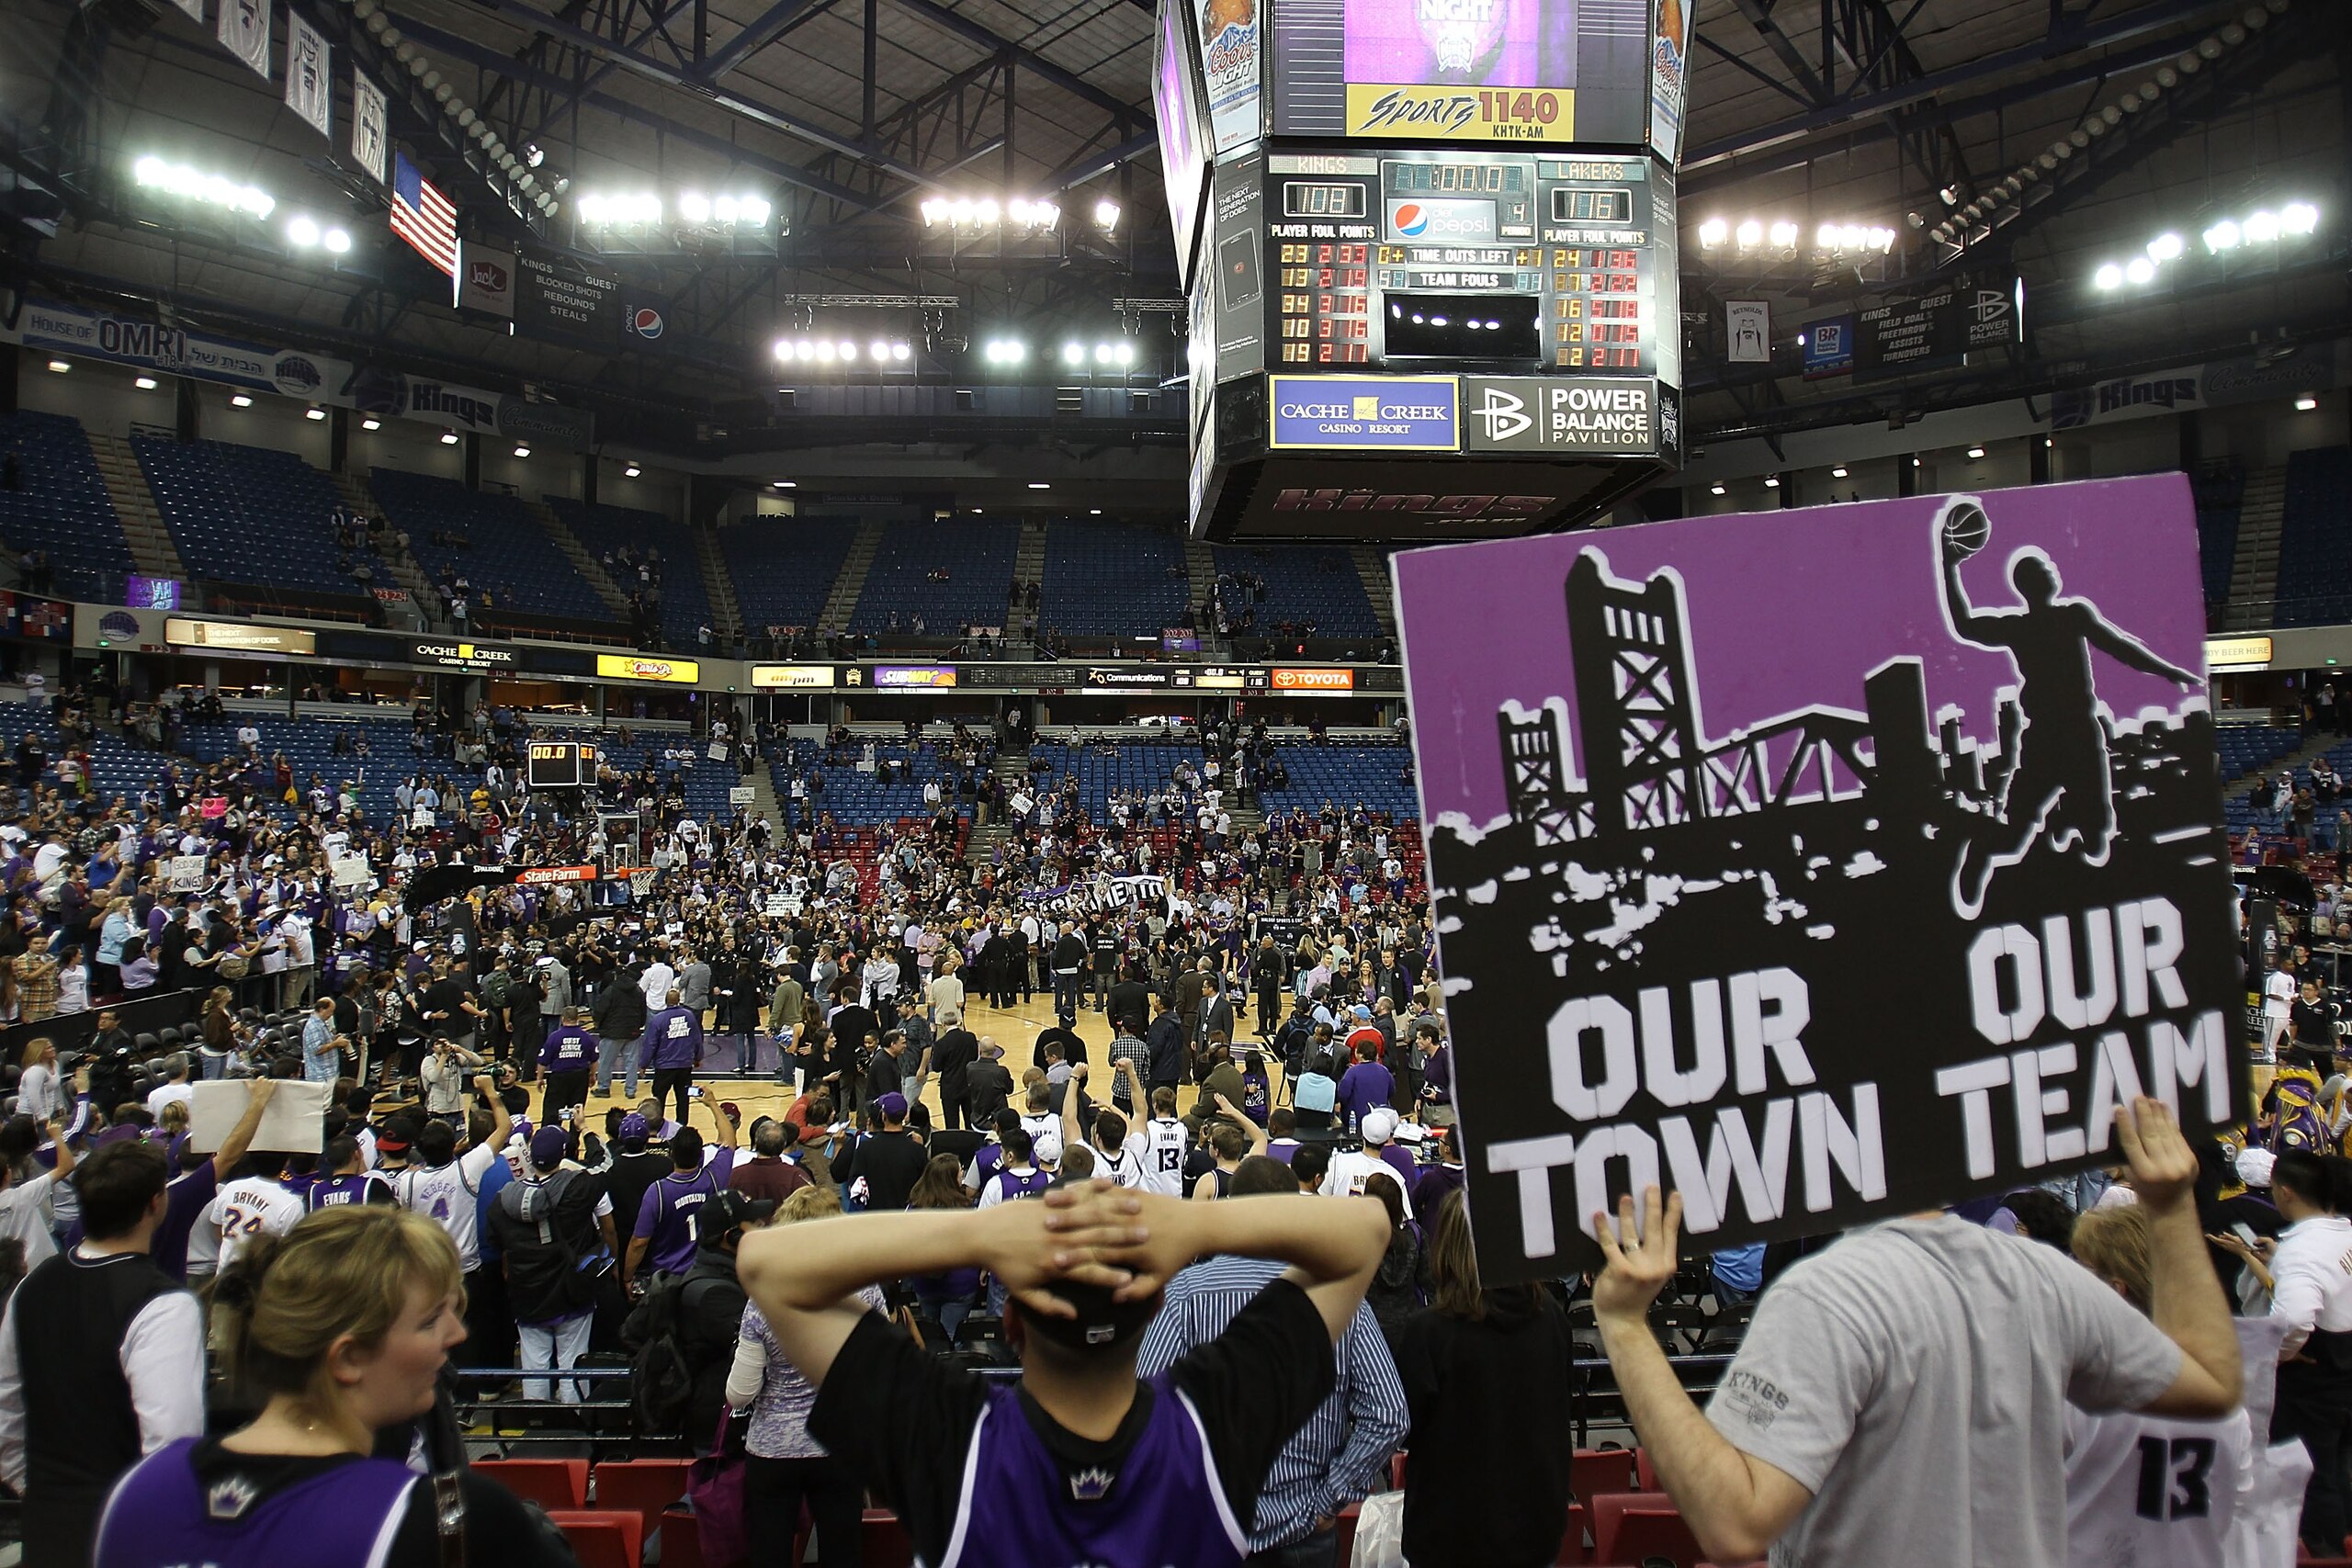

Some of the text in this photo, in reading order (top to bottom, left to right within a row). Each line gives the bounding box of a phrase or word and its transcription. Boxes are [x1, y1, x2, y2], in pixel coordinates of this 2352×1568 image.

[1420, 0, 1493, 20] NIGHT
[1213, 59, 1253, 91] LIGHT
[1479, 92, 1559, 124] 1140
[1493, 125, 1544, 139] KHTK-AM
[1298, 156, 1346, 174] KINGS
[1558, 162, 1623, 180] LAKERS
[1219, 186, 1250, 207] THE NEXT
[1219, 189, 1261, 215] GENERATION
[1302, 186, 1346, 213] 108
[1570, 193, 1612, 219] 116
[1220, 213, 1228, 222] OF
[1272, 224, 1375, 238] PLAYER FOUL POINTS
[1544, 230, 1645, 243] PLAYER FOUL POINTS
[1281, 244, 1308, 263] 23
[1318, 244, 1331, 263] 2
[1411, 249, 1510, 263] TIME OUTS LEFT
[1554, 250, 1580, 268] 24
[470, 265, 505, 290] Jack
[522, 258, 617, 291] KINGS GUEST
[1319, 268, 1332, 288] 2
[1420, 274, 1499, 287] TEAM FOULS
[537, 275, 602, 299] BLOCKED SHOTS
[544, 290, 595, 310] REBOUNDS
[1283, 295, 1309, 313] 34
[1319, 295, 1332, 313] 3
[1860, 294, 1953, 321] KINGS GUEST
[550, 305, 588, 321] STEALS
[1732, 307, 1763, 316] REYNOLDS
[1319, 319, 1332, 338] 3
[1879, 317, 1901, 329] FIELD
[1970, 320, 2008, 333] POWER
[31, 315, 187, 364] HOUSE OF OMRI
[1820, 327, 1838, 342] BR
[1889, 335, 1924, 349] ASSISTS
[1970, 328, 2009, 341] BALANCE
[1319, 344, 1332, 362] 2
[1883, 345, 1930, 362] TURNOVERS
[2099, 362, 2324, 413] Kings Community
[1552, 389, 1646, 411] POWER
[413, 383, 581, 441] Kings Community
[1281, 404, 1448, 421] CACHE CREEK
[1318, 423, 1410, 434] CASINO RESORT
[1553, 413, 1648, 431] BALANCE
[1553, 432, 1648, 445] PAVILION
[1272, 488, 1555, 516] Kings
[1164, 629, 1180, 637] 202
[152, 644, 171, 653] 123
[417, 645, 512, 661] CACHE CREEK
[2222, 646, 2269, 657] BEER HERE
[438, 658, 492, 668] CASINO RESORT
[881, 669, 940, 684] SUBWAY
[1107, 673, 1166, 682] Communications
[1297, 673, 1350, 685] TOYOTA
[532, 746, 566, 760] 00.0
[175, 860, 188, 870] GOD
[473, 864, 504, 874] SPALDING
[174, 875, 203, 888] KINGS
[1966, 897, 2191, 1045] OUR
[670, 1016, 686, 1024] GUEST
[666, 1028, 691, 1039] SECURITY
[1546, 965, 1817, 1121] OUR
[1936, 1010, 2232, 1180] TEAM
[1160, 1133, 1178, 1142] EVANS
[1158, 1147, 1180, 1172] 13
[1487, 1081, 1887, 1259] TOWN
[323, 1191, 352, 1207] EVANS
[420, 1180, 457, 1201] WEBBER
[233, 1191, 271, 1213] BRYANT
[430, 1198, 449, 1221] 4
[674, 1193, 707, 1210] MONTALVO
[223, 1206, 265, 1237] 24
[685, 1213, 696, 1241] 1
[1728, 1371, 1789, 1411] KINGS
[2136, 1436, 2217, 1522] 13
